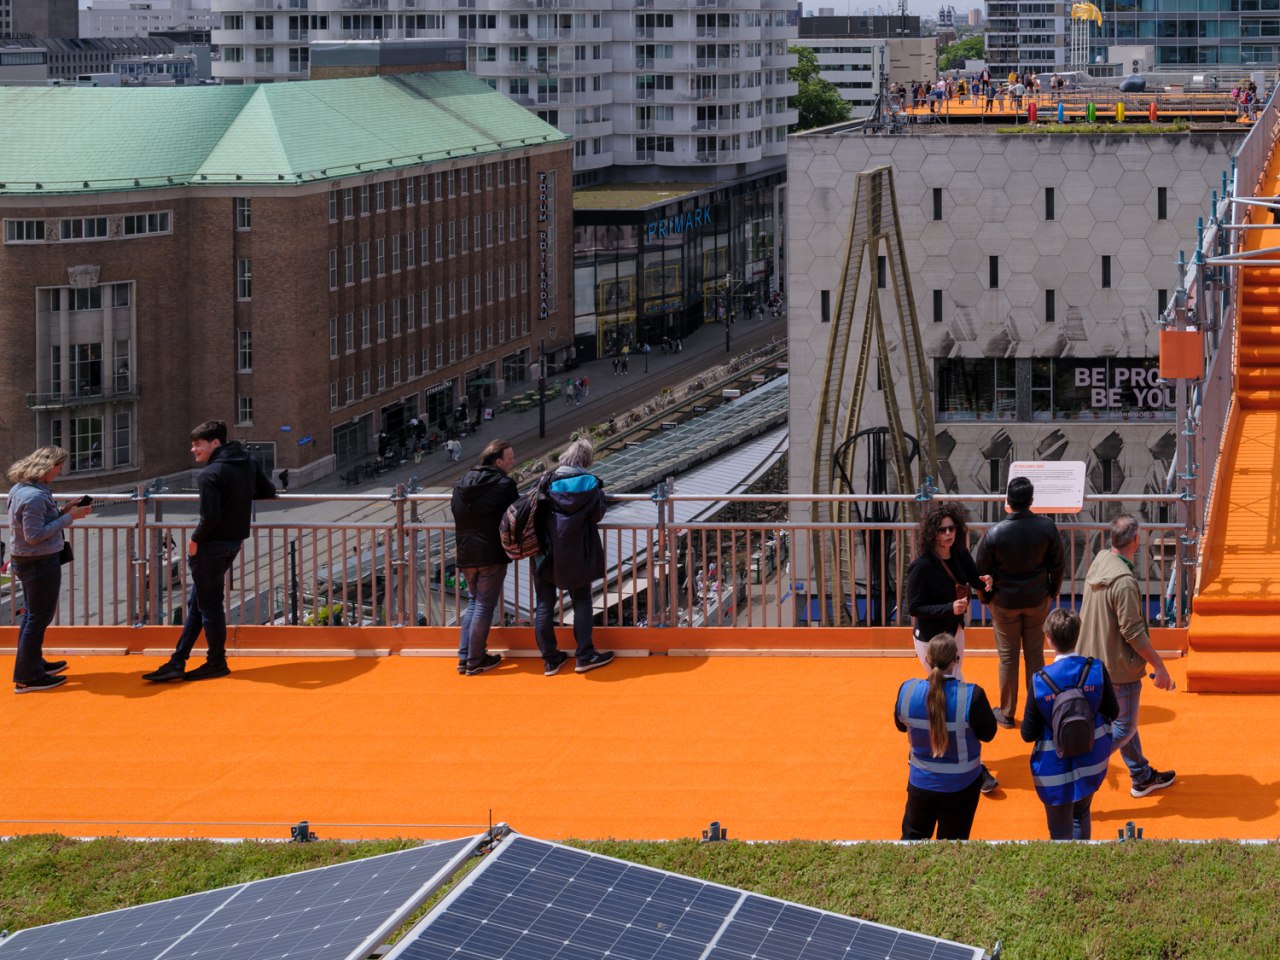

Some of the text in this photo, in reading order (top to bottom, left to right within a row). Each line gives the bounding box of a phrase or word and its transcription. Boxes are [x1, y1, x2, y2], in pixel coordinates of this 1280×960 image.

[646, 206, 712, 243] PRIMARK
[540, 232, 548, 319] ROTTERDAM
[1074, 367, 1162, 387] BE PRO
[1091, 388, 1177, 409] BE YOU
